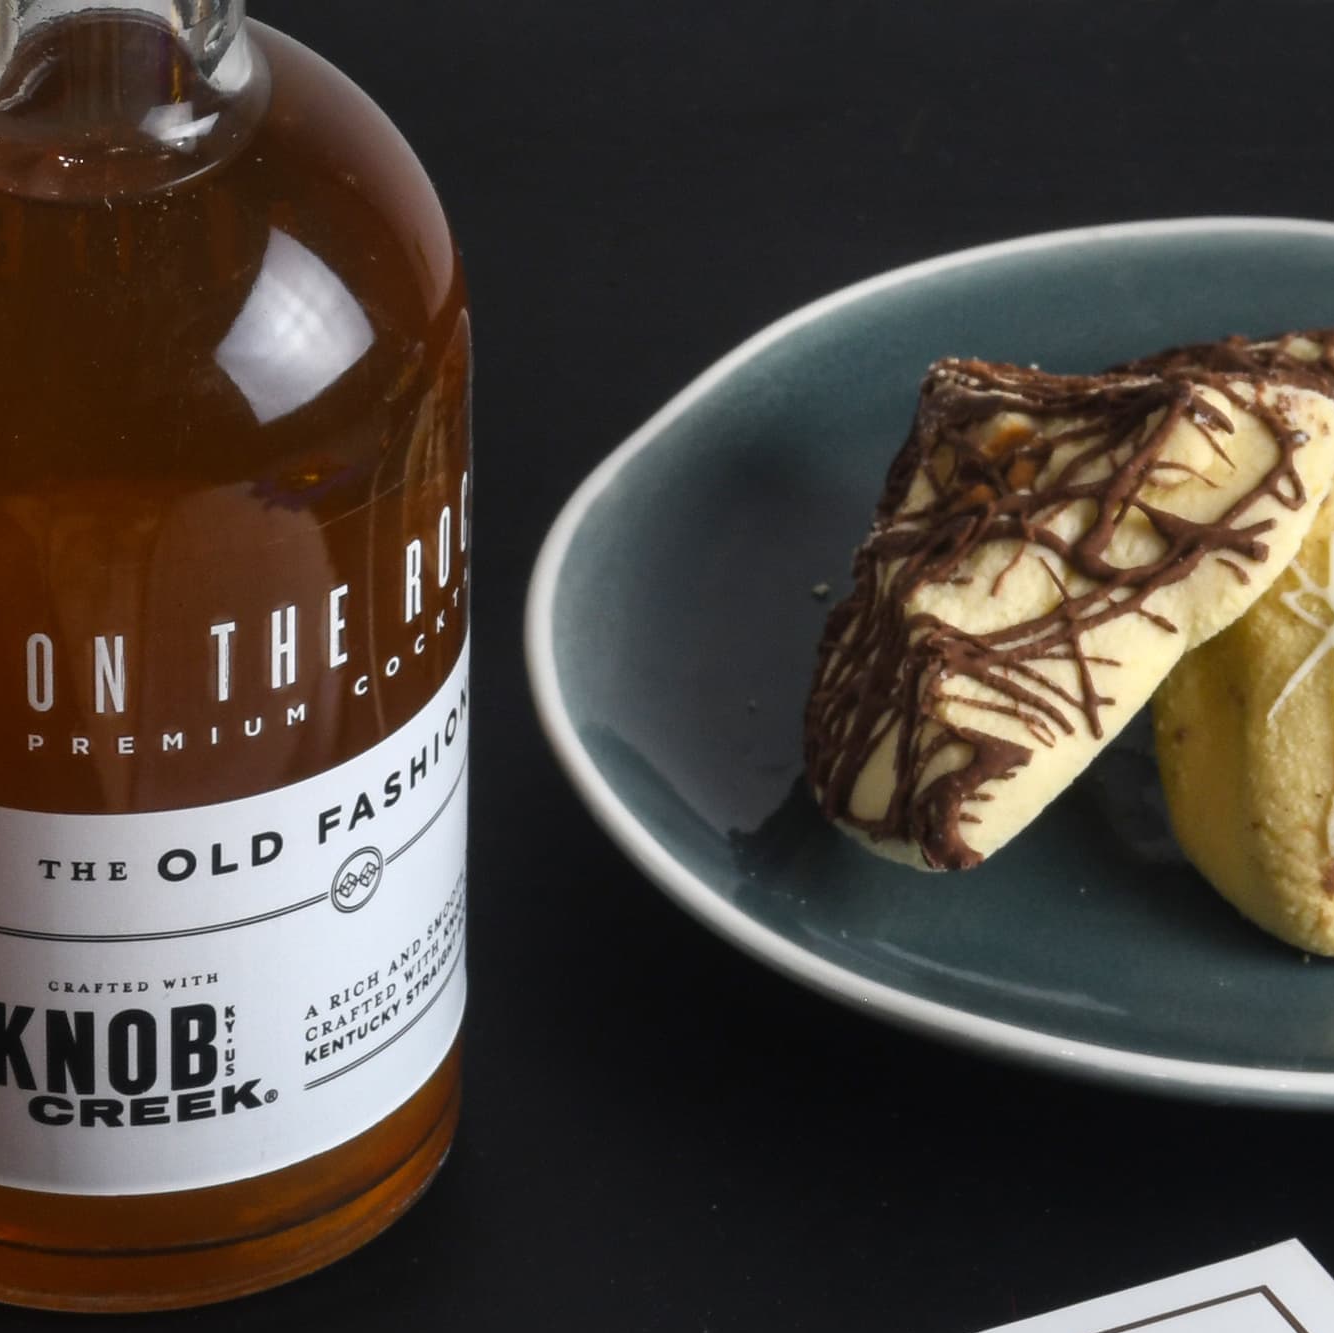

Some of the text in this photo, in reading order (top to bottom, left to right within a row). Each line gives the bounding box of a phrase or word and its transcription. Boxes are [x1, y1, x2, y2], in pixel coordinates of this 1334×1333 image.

[26, 632, 126, 713] ON
[210, 583, 349, 702] THE
[27, 704, 307, 756] PREMIUM
[38, 857, 128, 882] THE
[157, 830, 284, 884] OLD
[48, 972, 219, 994] CRAFTED WITH
[304, 1004, 318, 1020] A
[329, 970, 380, 1010] RICH
[387, 938, 421, 976] AND
[305, 982, 396, 1043] CRAFTED
[403, 937, 440, 984] WITH
[305, 999, 401, 1066] KENTUCKY
